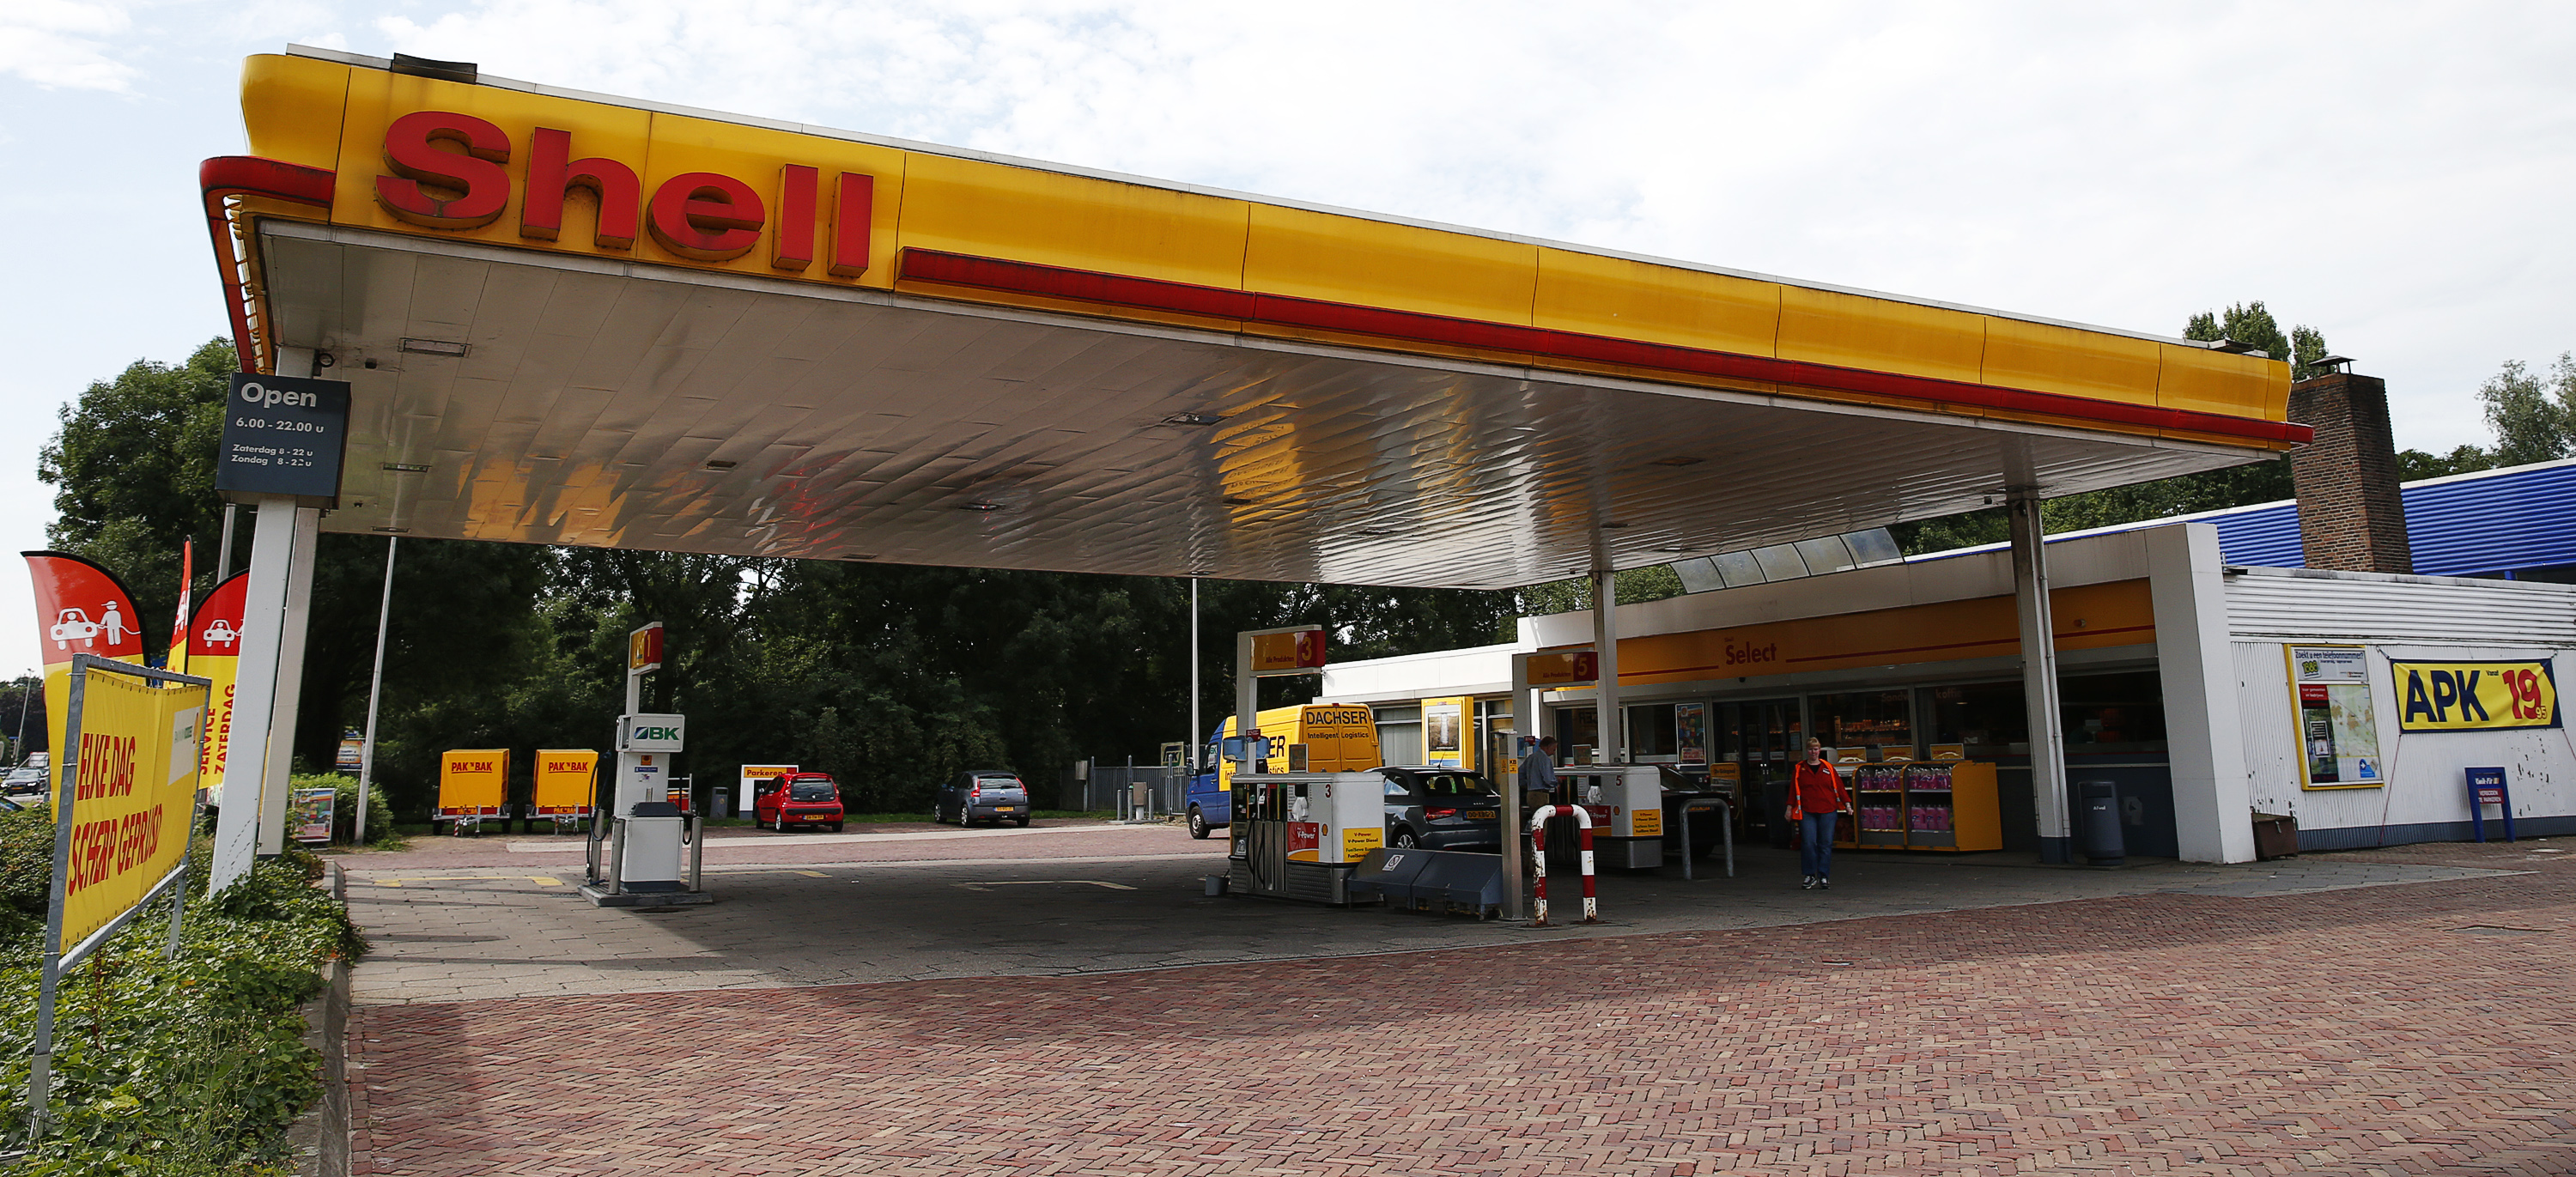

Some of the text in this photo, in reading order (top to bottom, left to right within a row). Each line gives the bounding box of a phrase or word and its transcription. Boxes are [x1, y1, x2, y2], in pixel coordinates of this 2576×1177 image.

[375, 111, 874, 279] Shell
[240, 382, 317, 409] Open
[235, 417, 264, 428] 6.00
[276, 420, 313, 432] 22.00
[232, 444, 276, 456] Zaterdag
[231, 455, 269, 466] Zondag
[1302, 636, 1312, 661] 3
[1725, 640, 1777, 665] Select
[1577, 657, 1588, 676] 5
[2404, 670, 2490, 723] APK
[2501, 669, 2542, 720] 19
[2535, 707, 2548, 719] 95
[1306, 711, 1368, 725] DACHSER
[648, 726, 680, 741] BK
[1308, 731, 1340, 740] Intelligent
[77, 732, 137, 801] ELKE DAG
[452, 761, 468, 772] PAK
[475, 761, 493, 772] BAK
[549, 761, 564, 772] PAK
[571, 761, 588, 772] BAK
[1615, 775, 1623, 786] 5
[1325, 783, 1332, 798] 3
[1297, 830, 1315, 840] V-Power
